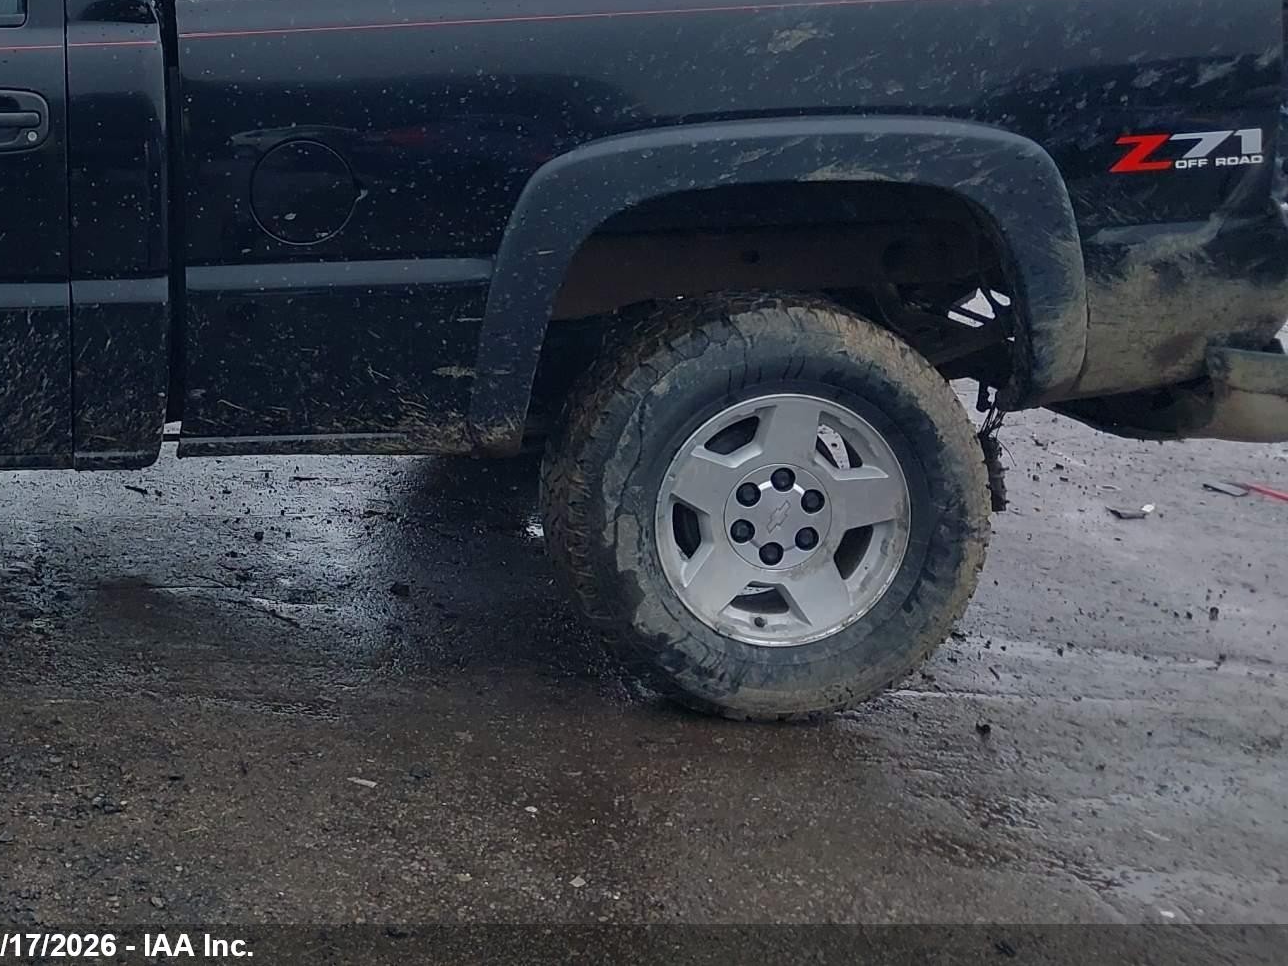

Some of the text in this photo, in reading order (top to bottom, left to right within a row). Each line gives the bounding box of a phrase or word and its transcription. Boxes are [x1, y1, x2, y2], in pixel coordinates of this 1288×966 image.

[1109, 128, 1262, 172] Z71
[1175, 155, 1264, 169] OFF ROAD
